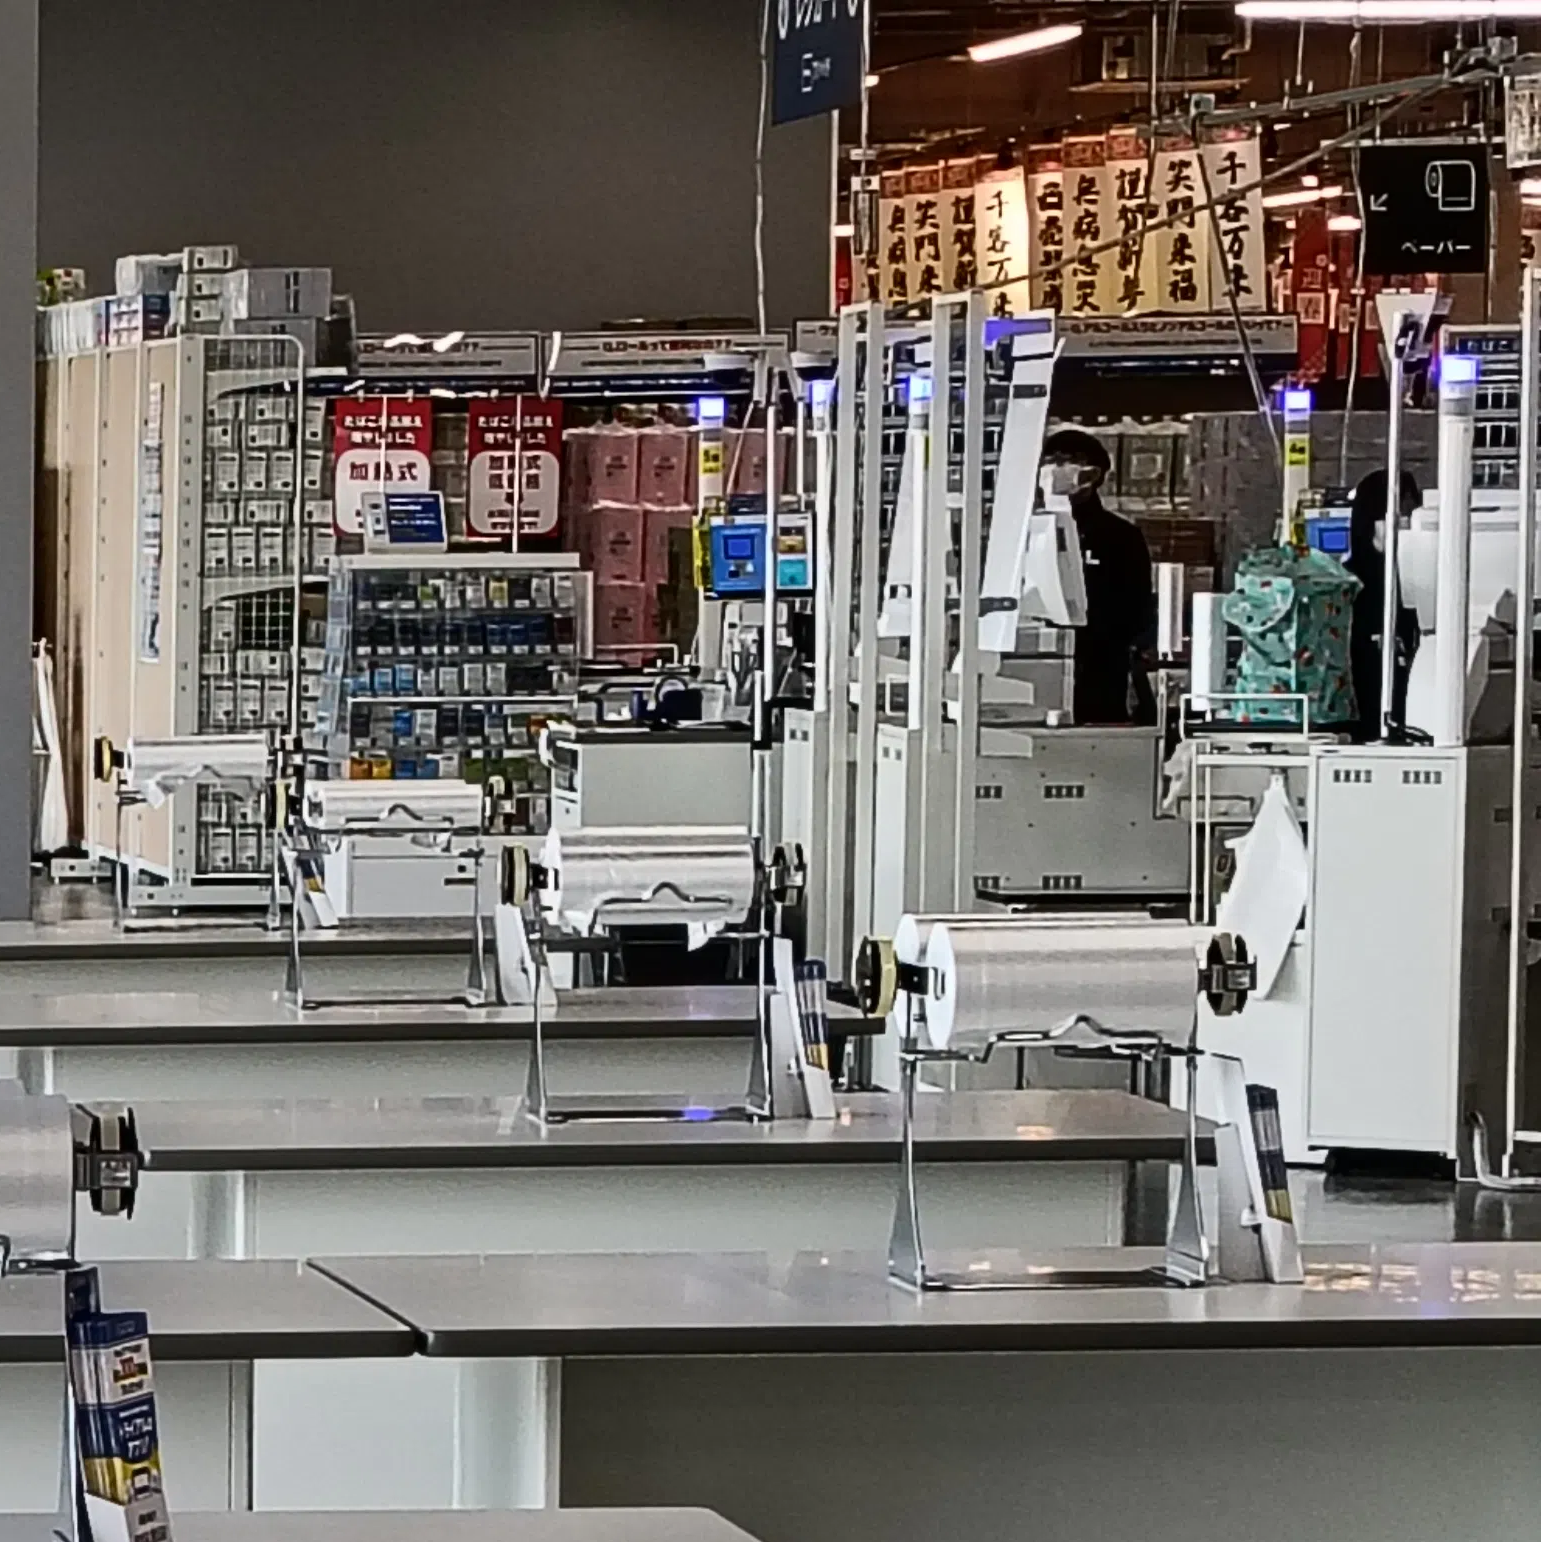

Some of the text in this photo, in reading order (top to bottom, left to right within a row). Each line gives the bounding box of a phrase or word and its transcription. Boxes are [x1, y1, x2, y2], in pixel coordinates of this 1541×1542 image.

[914, 200, 942, 294] 笑門来
[951, 194, 979, 290] 謹賀新
[1166, 159, 1198, 303] 笑門来福
[478, 415, 554, 428] たばこ品揃え
[484, 432, 547, 444] 増やしした
